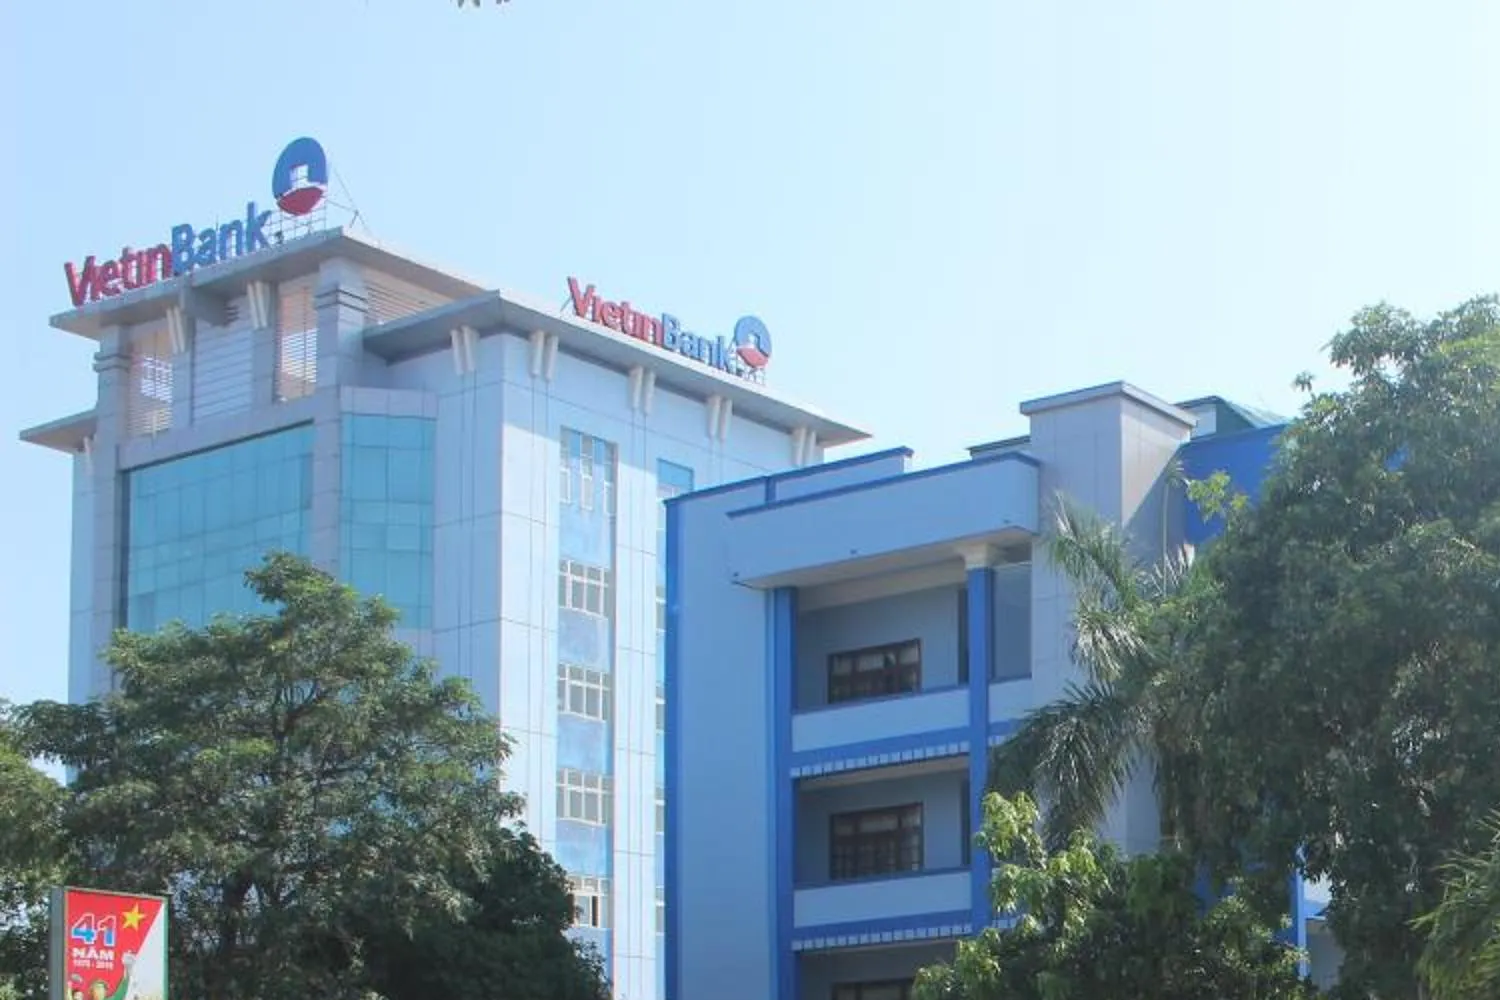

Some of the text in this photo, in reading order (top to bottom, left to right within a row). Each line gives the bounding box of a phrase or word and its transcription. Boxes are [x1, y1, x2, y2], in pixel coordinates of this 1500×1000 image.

[64, 201, 275, 308] VietinBank
[566, 275, 737, 373] VietinBank
[72, 913, 116, 947] 41
